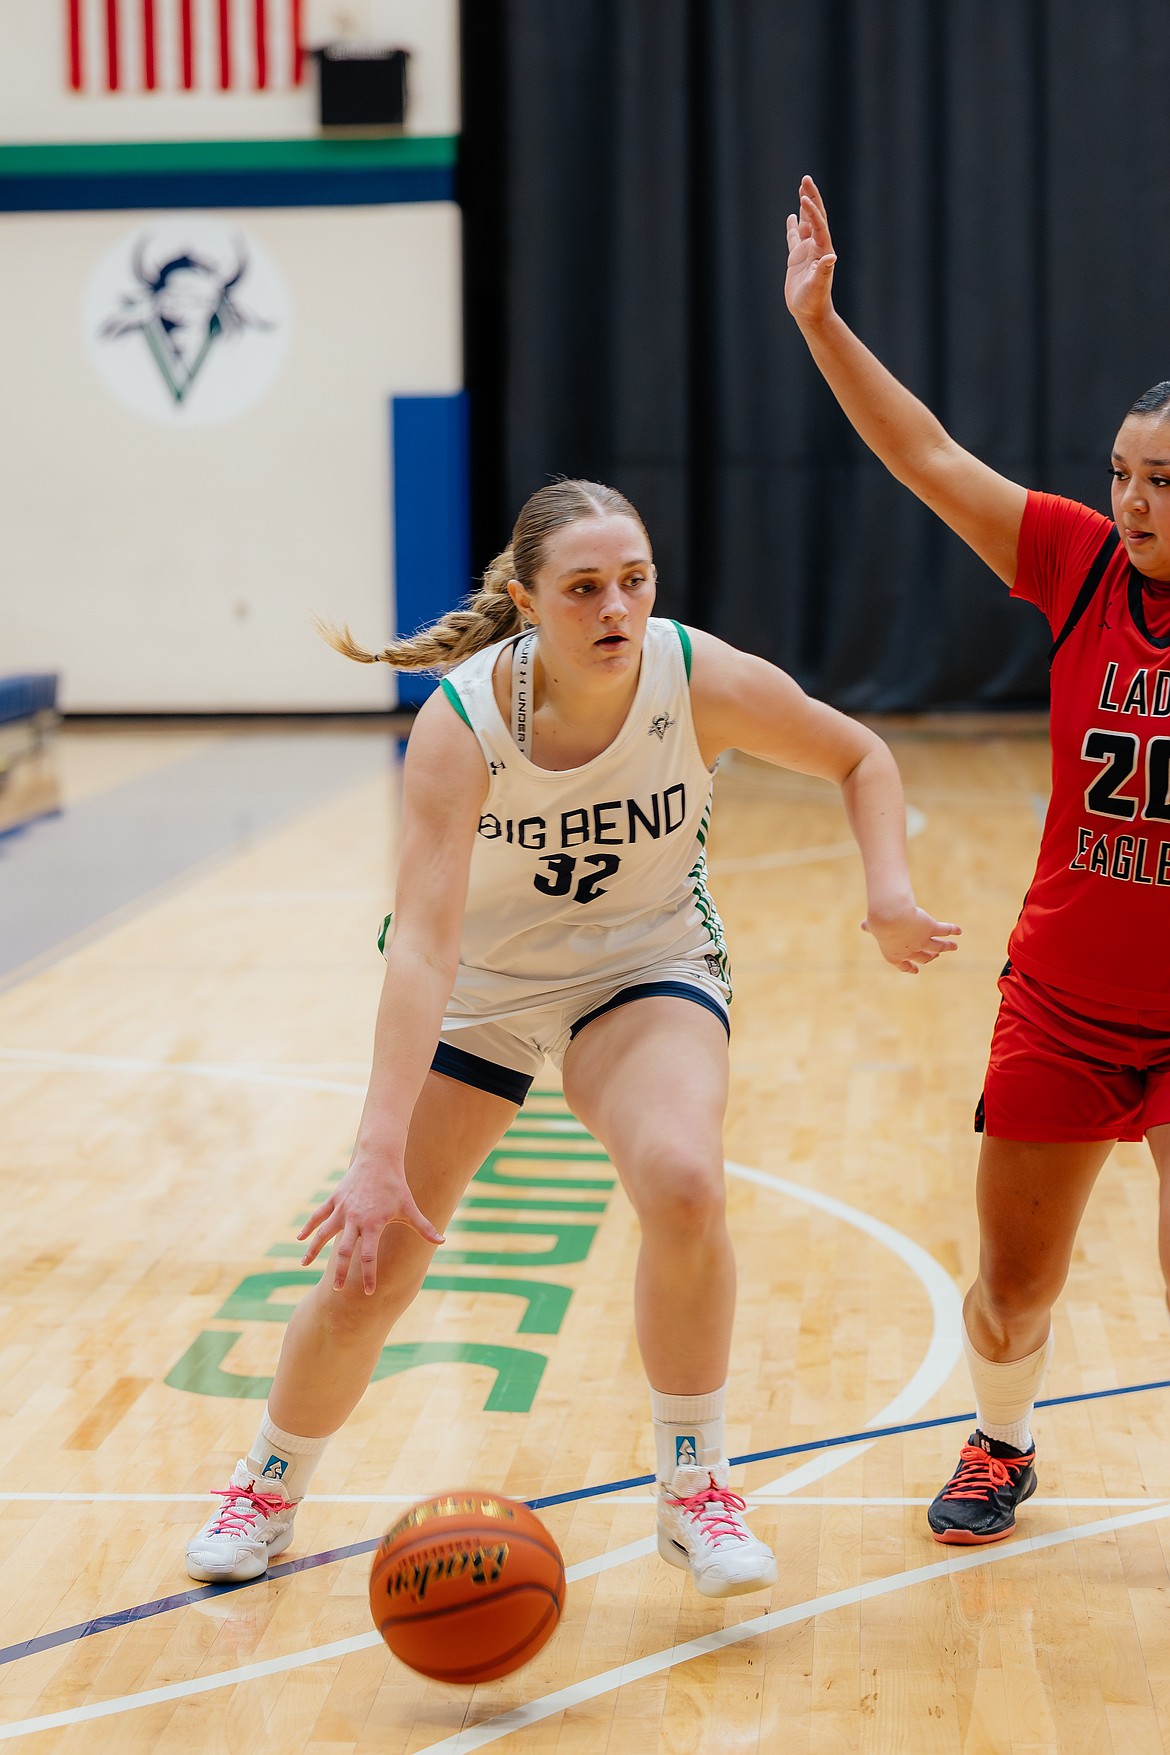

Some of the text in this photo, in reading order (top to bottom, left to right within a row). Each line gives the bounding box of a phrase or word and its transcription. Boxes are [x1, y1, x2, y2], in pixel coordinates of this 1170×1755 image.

[517, 691, 527, 742] UNDER
[477, 782, 686, 850] BIG BEND
[533, 852, 622, 905] 32
[1068, 826, 1170, 887] EAGLE
